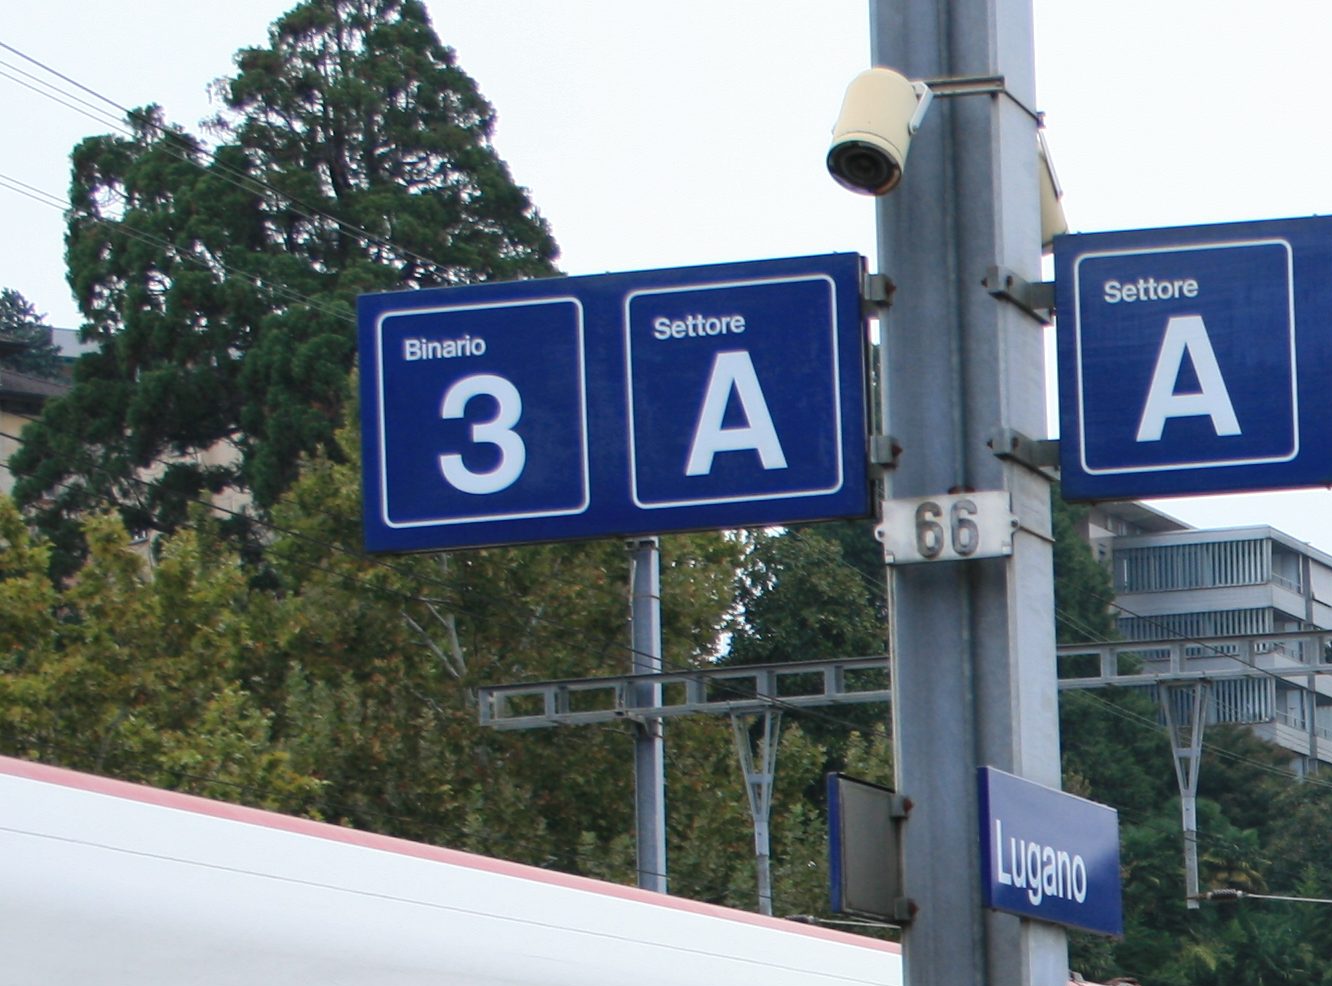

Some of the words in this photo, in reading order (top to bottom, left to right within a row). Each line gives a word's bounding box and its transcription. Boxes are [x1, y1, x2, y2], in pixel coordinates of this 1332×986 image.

[653, 313, 746, 341] Settore
[1103, 277, 1199, 303] Settore
[404, 335, 487, 361] Binario
[1135, 314, 1243, 443] A
[439, 374, 527, 495] 3
[685, 350, 788, 477] A
[915, 499, 980, 560] 66
[996, 818, 1088, 907] Lugano
